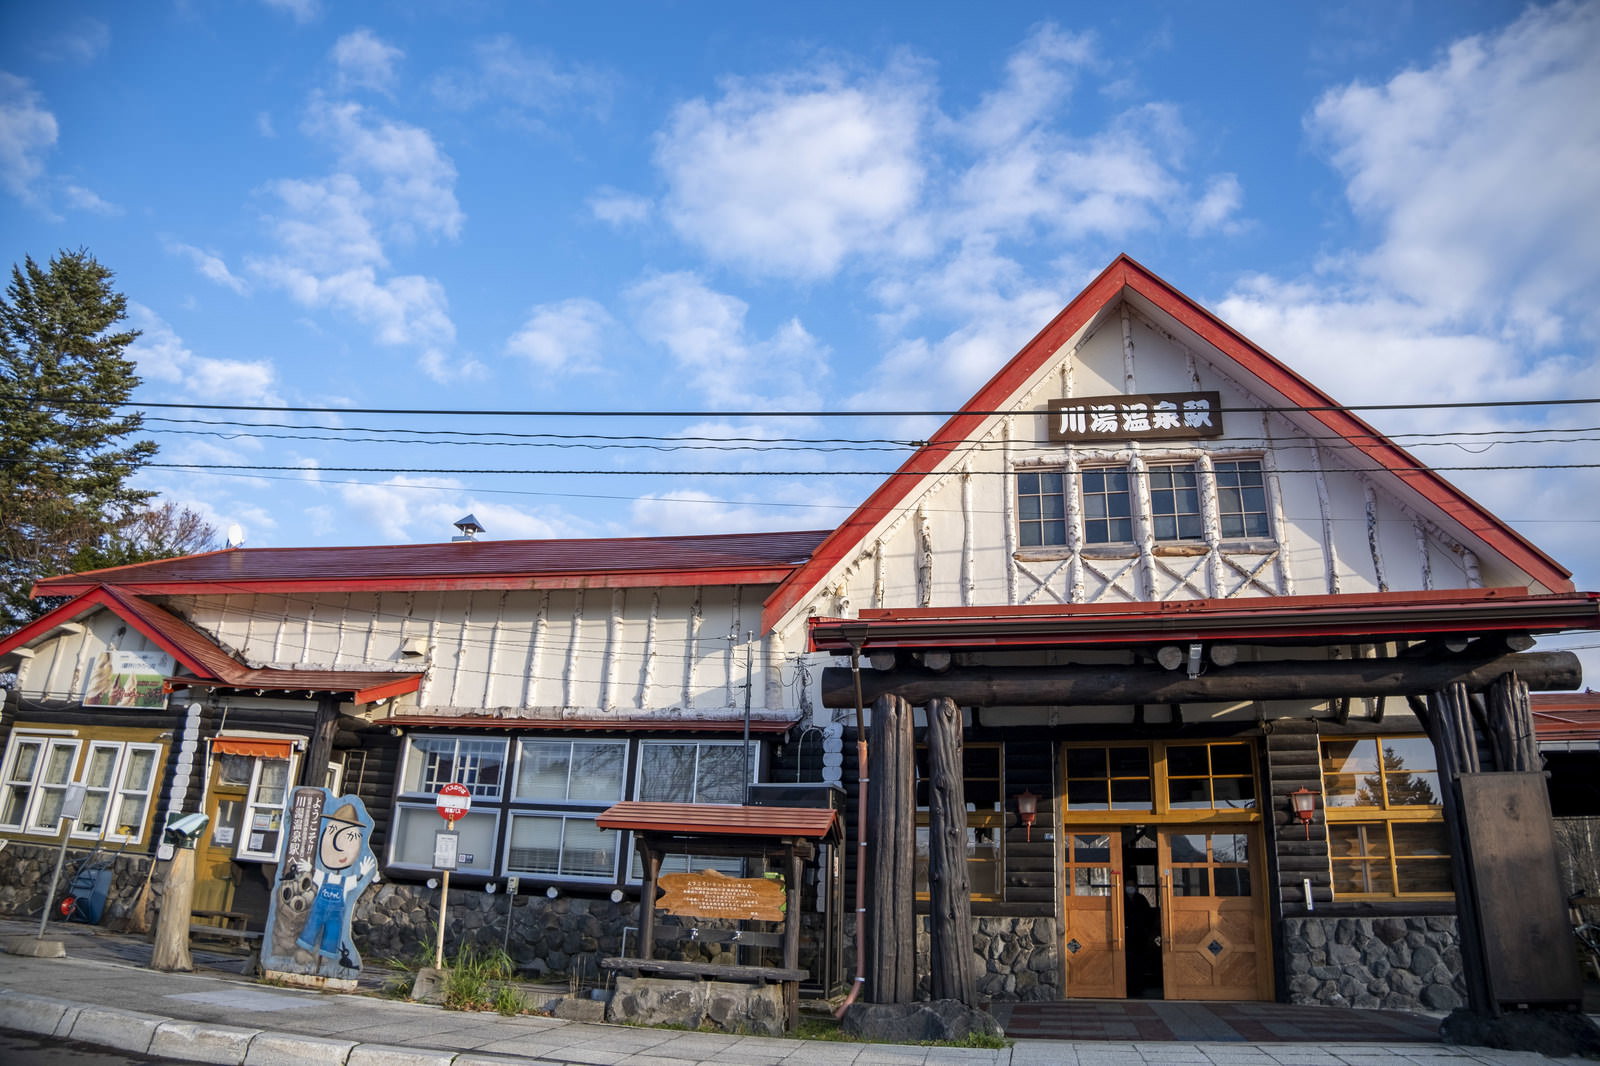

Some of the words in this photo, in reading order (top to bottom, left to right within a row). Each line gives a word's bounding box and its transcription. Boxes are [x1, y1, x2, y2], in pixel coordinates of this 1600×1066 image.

[1060, 400, 1213, 434] 川湯温泉駅
